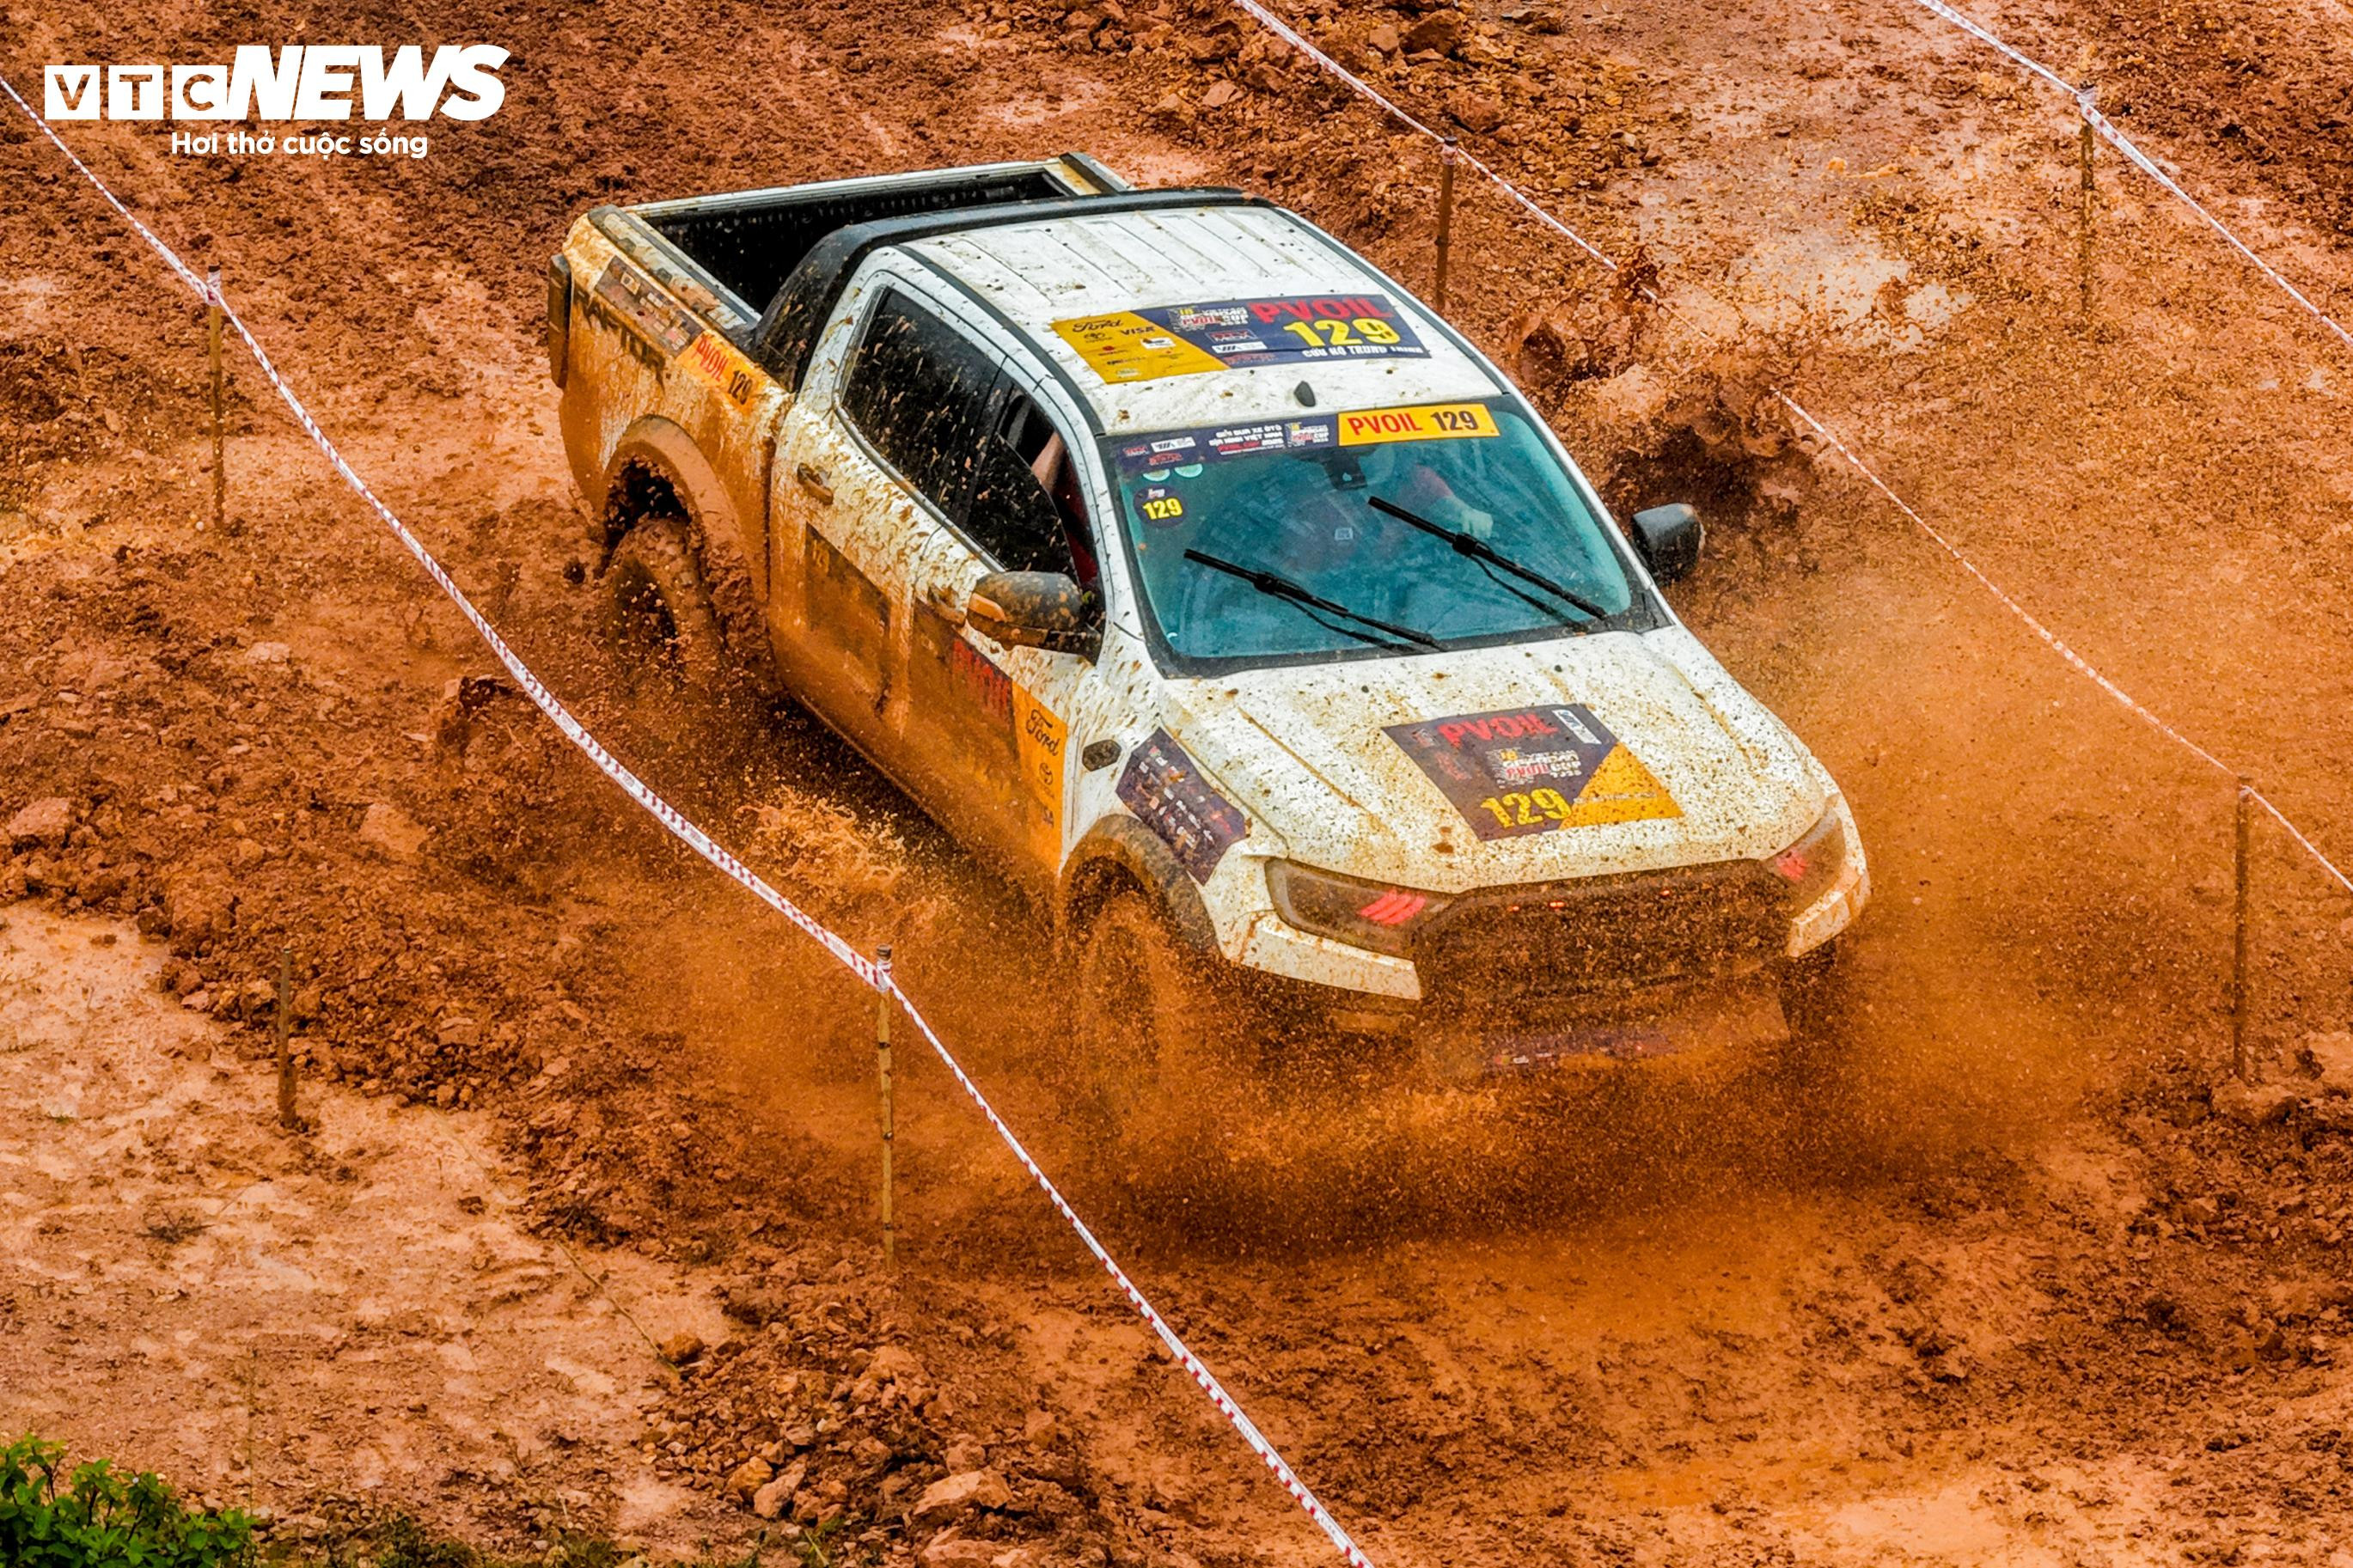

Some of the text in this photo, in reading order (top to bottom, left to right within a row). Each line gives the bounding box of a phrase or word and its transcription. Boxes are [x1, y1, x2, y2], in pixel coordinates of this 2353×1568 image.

[1248, 296, 1394, 324] PVOIL
[1073, 320, 1123, 333] Ford
[1120, 326, 1155, 336] VISA
[1283, 318, 1401, 347] 129
[1348, 412, 1422, 436] PVOIL
[1430, 411, 1479, 431] 129
[1142, 497, 1183, 520] 129
[1026, 709, 1059, 756] Ford
[1437, 713, 1560, 748] PVOIL
[1481, 788, 1573, 828] 129
